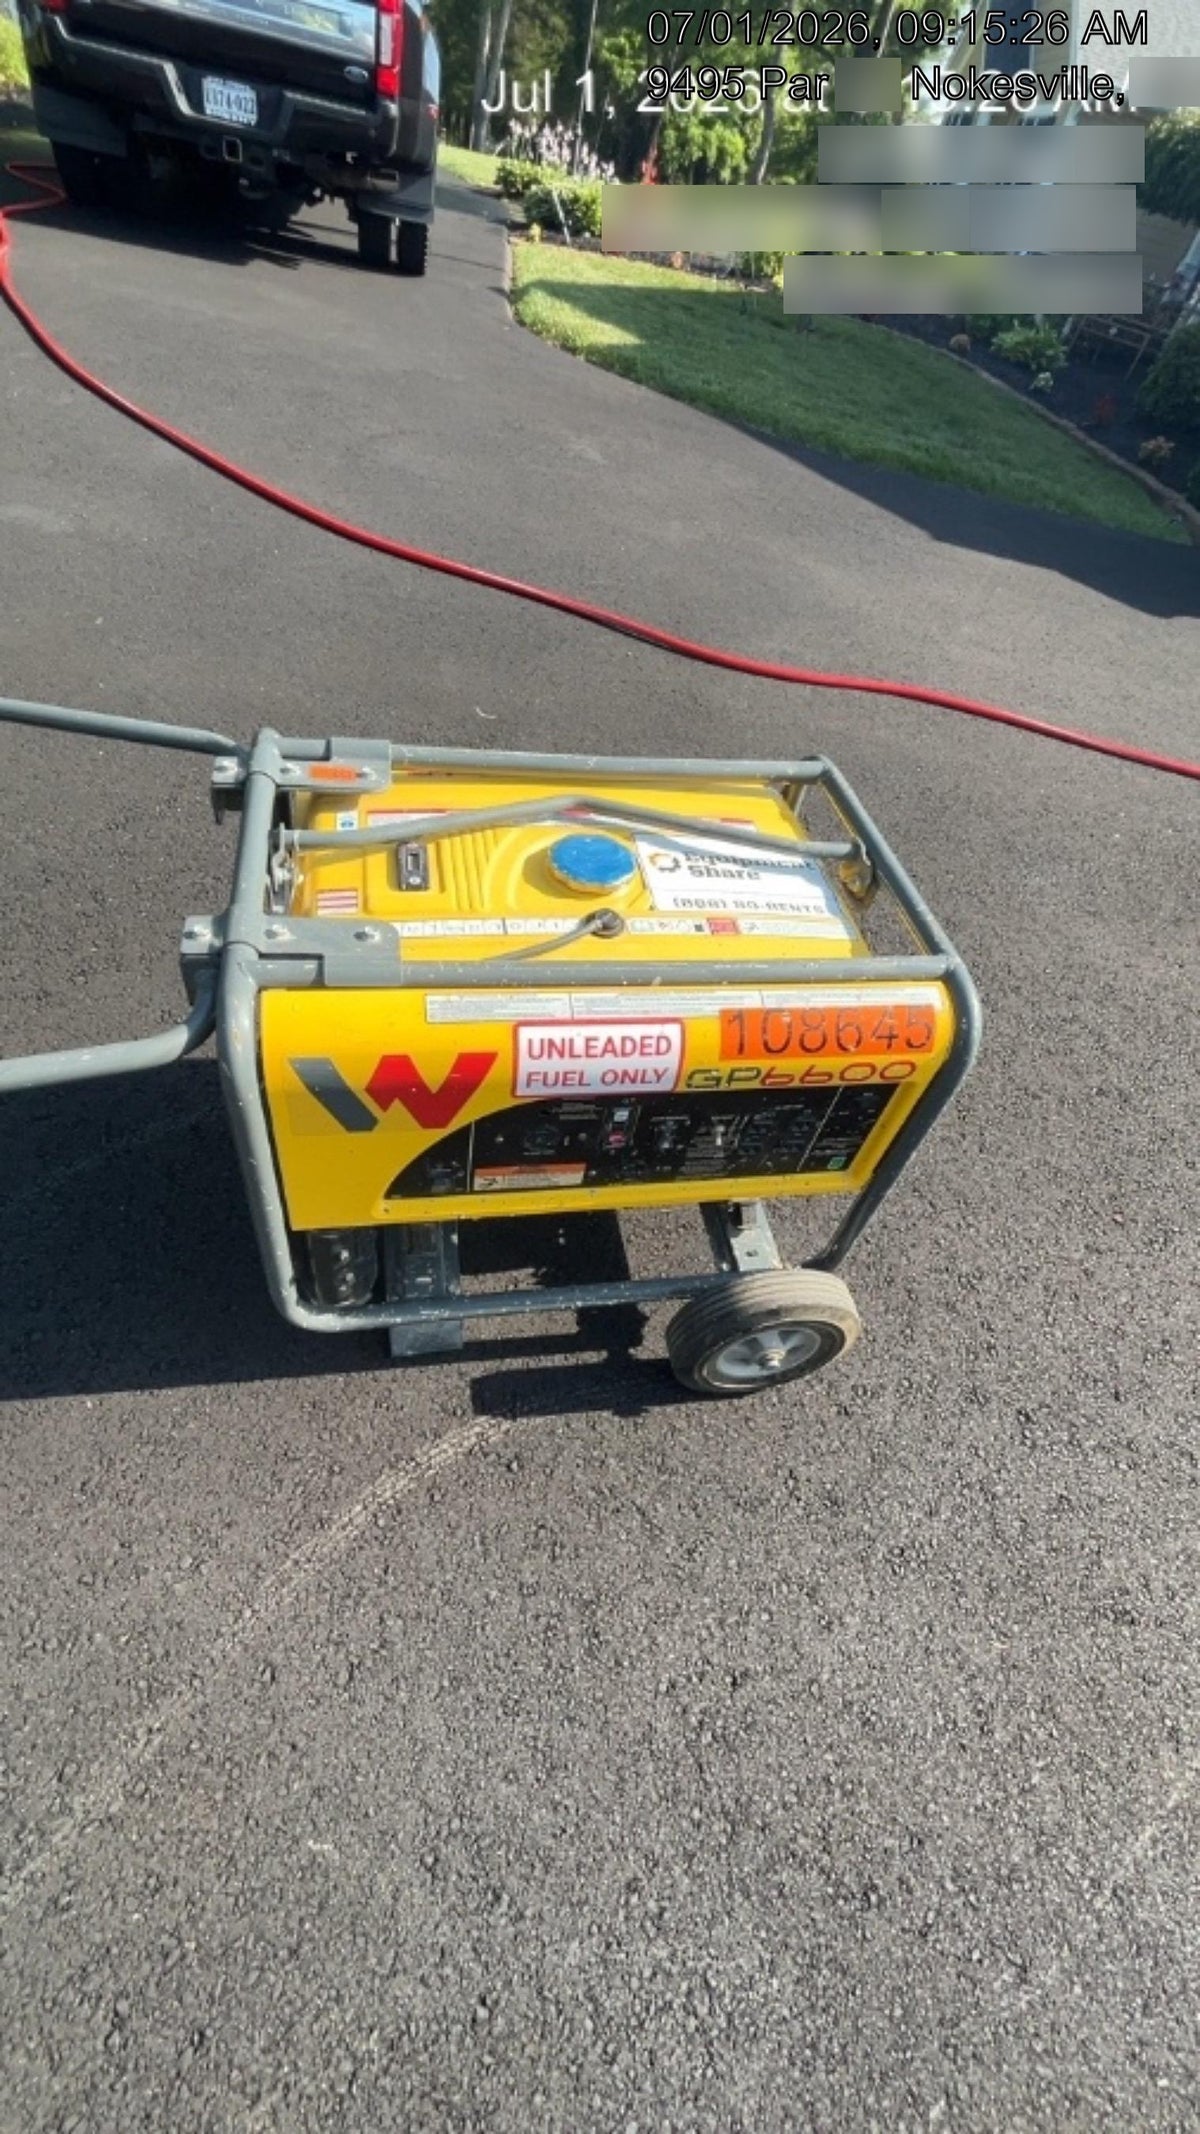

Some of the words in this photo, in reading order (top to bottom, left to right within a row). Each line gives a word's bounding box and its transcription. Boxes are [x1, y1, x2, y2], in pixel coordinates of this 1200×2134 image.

[684, 852, 816, 872] Equipment
[687, 864, 761, 881] Share
[728, 1005, 934, 1056] 108645
[526, 1034, 672, 1061] UNLEADED
[526, 1068, 591, 1089] FUEL
[600, 1066, 670, 1088] ONLY
[685, 1061, 918, 1090] GP6600
